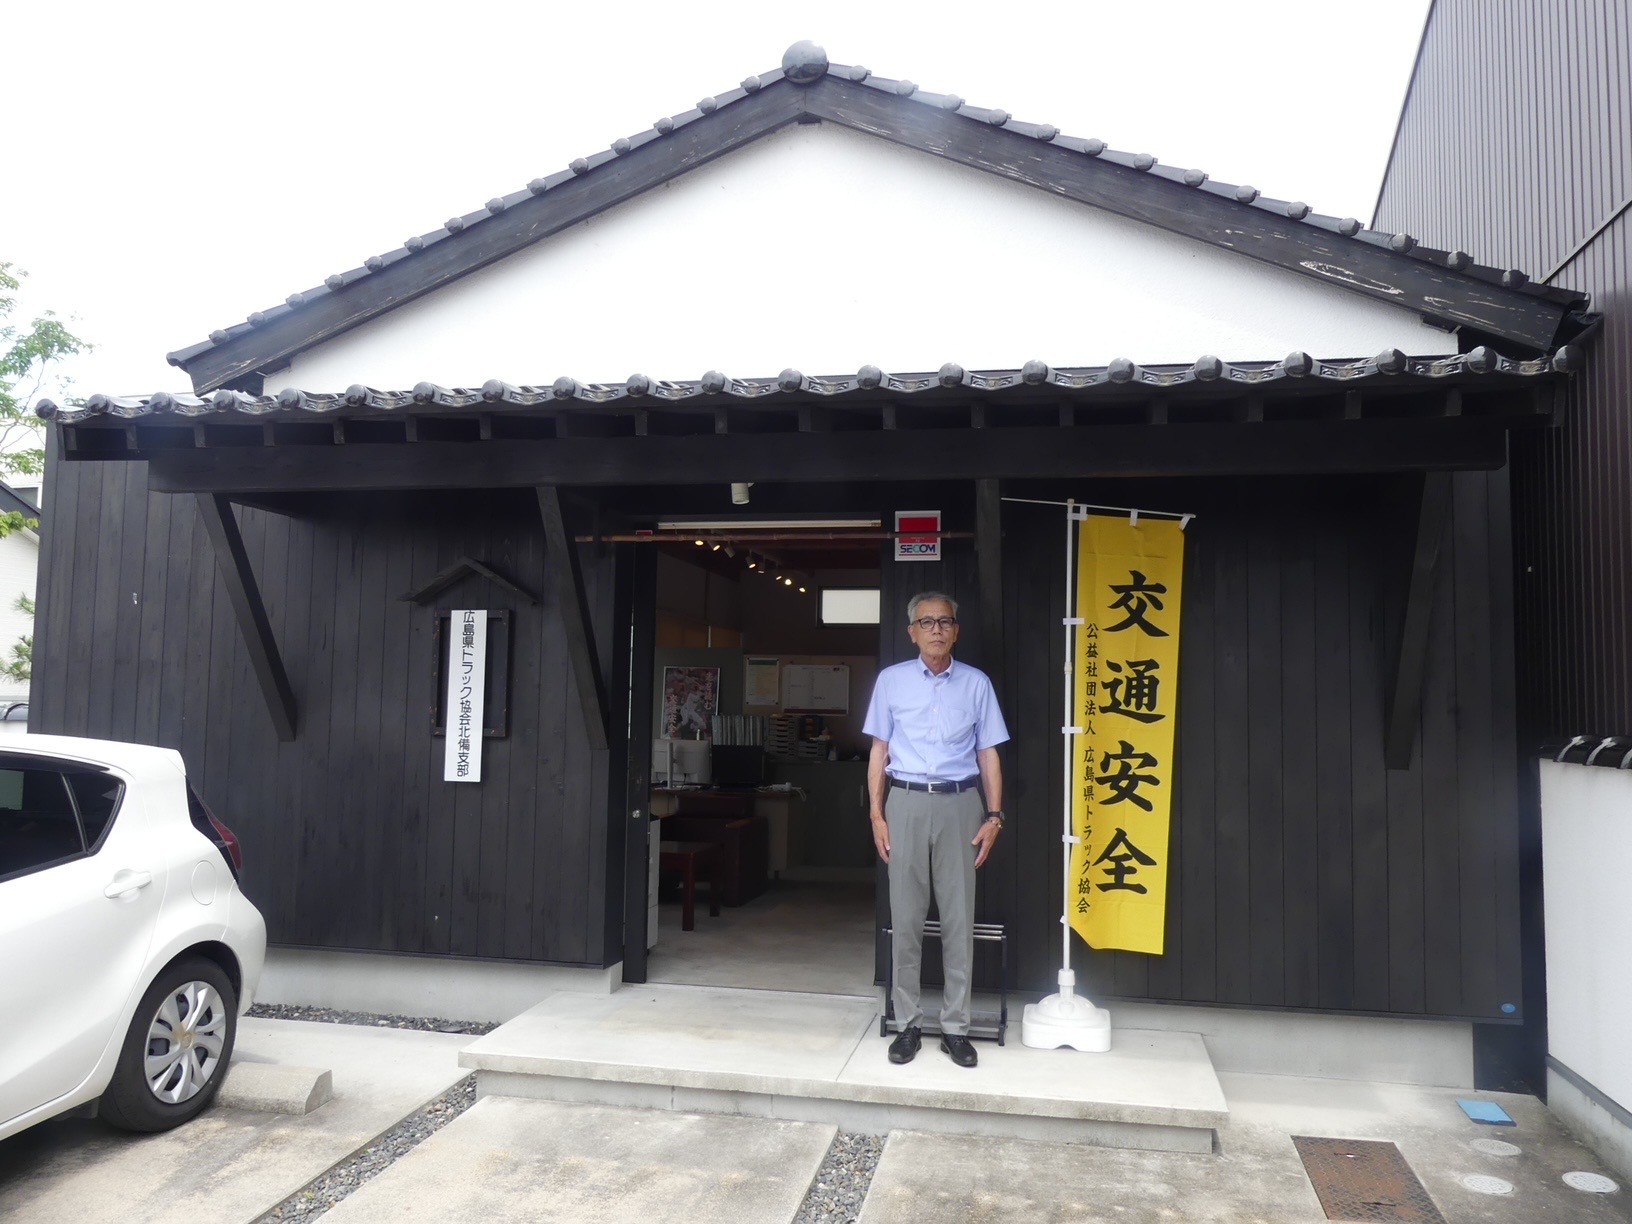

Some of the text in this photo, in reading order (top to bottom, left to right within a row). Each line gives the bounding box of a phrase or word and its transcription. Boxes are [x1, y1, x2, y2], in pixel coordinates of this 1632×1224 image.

[900, 544, 936, 553] SECOM
[456, 610, 475, 777] 広島県トラック協会北備支部
[1076, 622, 1099, 914] 公益社団法人 広島県トラック協会
[1092, 570, 1170, 894] 交通安全
